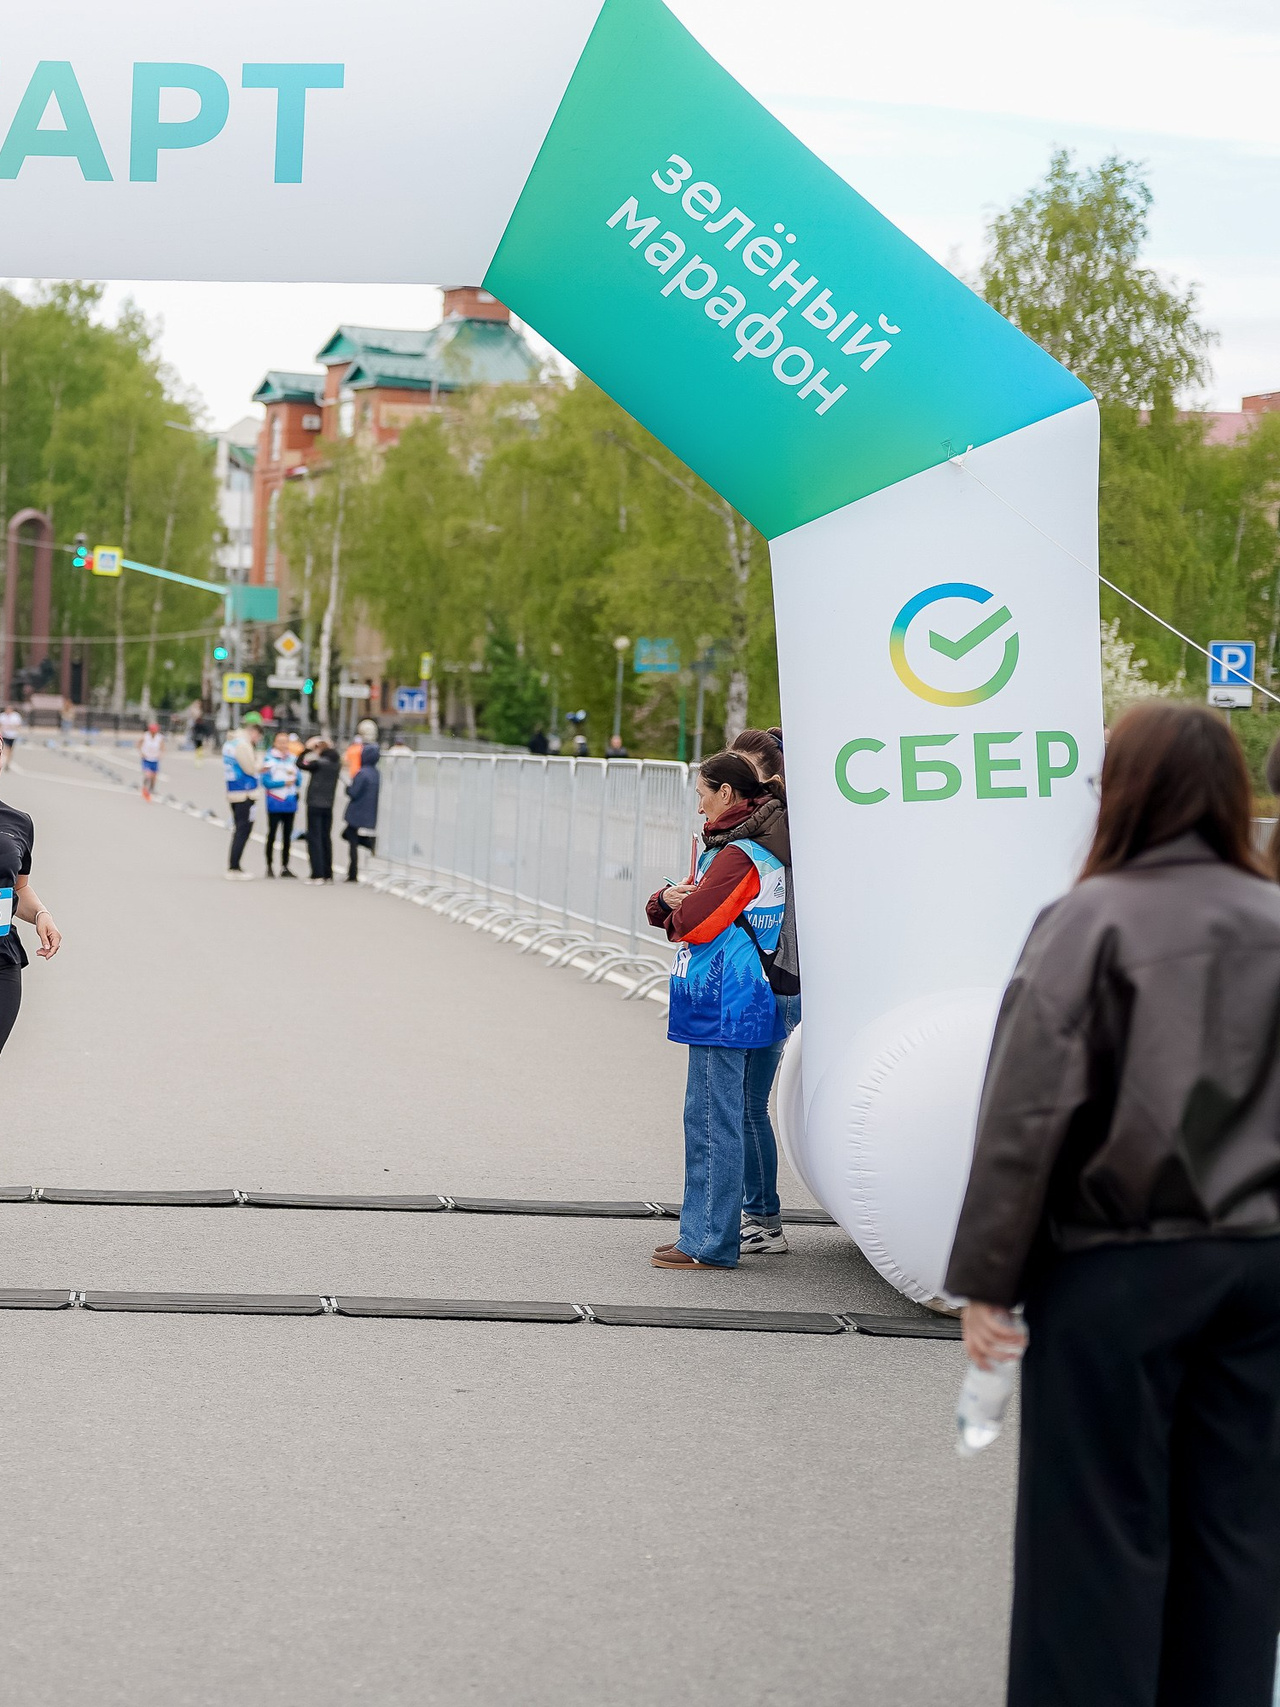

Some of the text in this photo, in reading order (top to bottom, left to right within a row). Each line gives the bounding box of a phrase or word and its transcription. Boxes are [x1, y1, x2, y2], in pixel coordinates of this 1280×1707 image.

[605, 195, 849, 416] марафон
[650, 153, 902, 373] зелёный
[1221, 646, 1247, 682] P
[834, 731, 1079, 805] СБЕР
